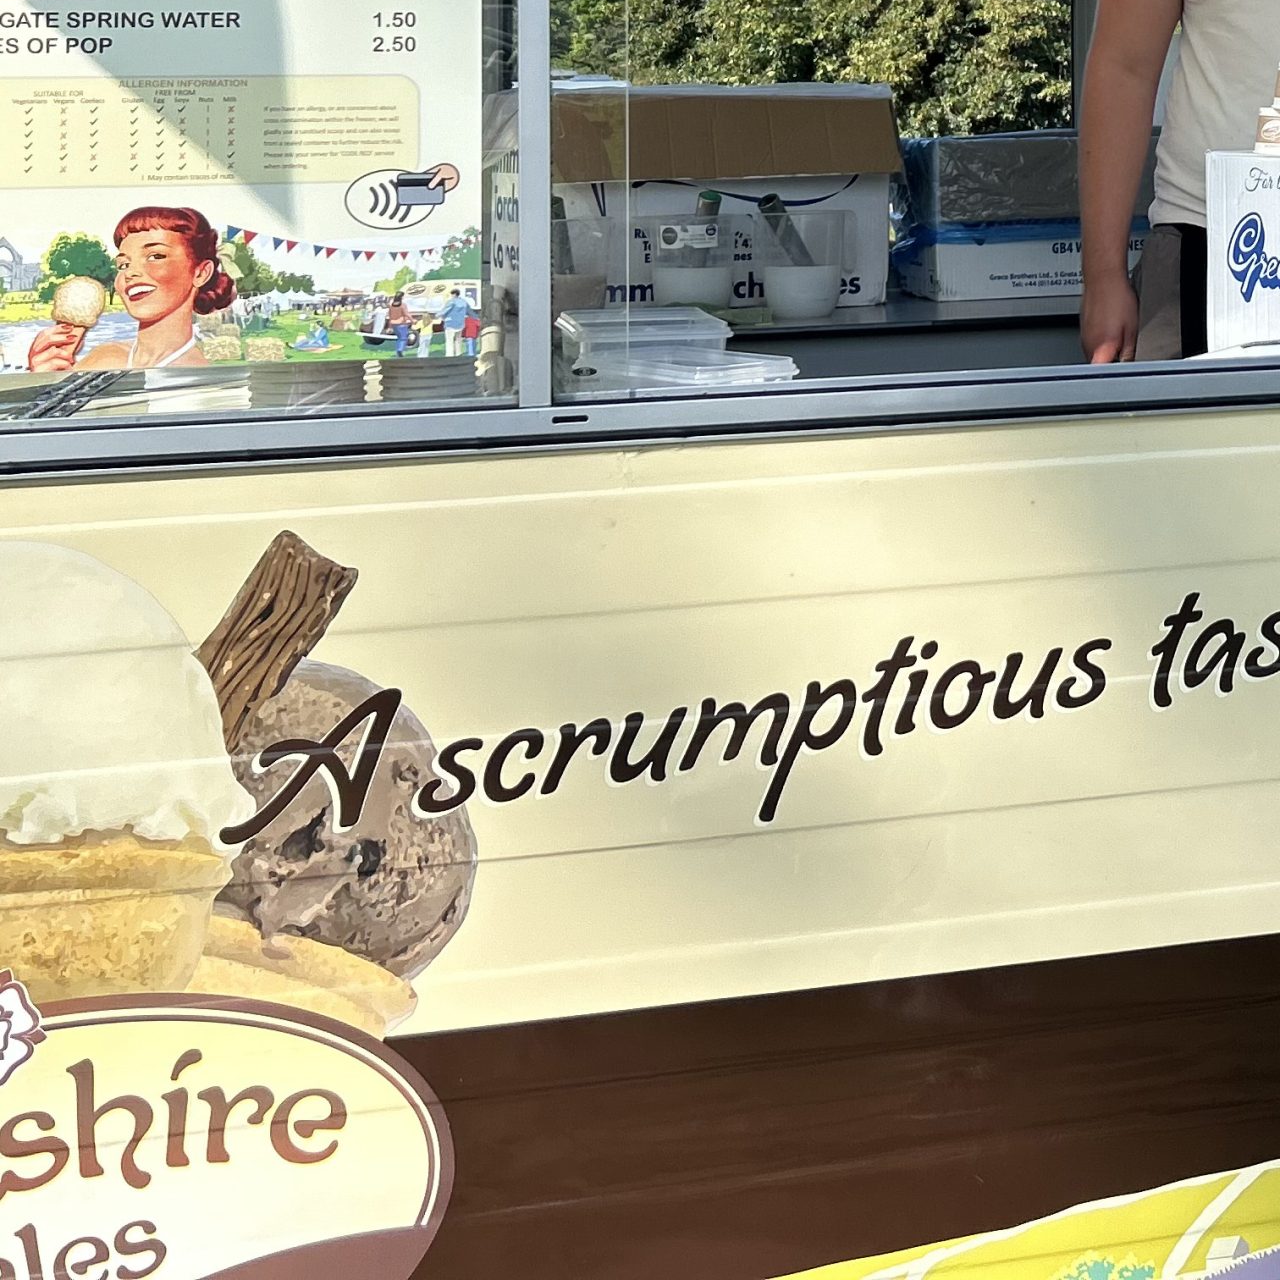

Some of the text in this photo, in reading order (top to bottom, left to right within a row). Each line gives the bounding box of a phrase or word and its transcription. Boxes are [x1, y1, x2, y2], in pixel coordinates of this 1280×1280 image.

[0, 11, 241, 29] GATE SPRING WATER
[372, 11, 417, 28] 1.50
[27, 37, 58, 54] OF
[65, 36, 113, 54] POP
[372, 36, 417, 53] 2.50
[118, 78, 248, 89] ALLERGEN INFORMATION
[1244, 166, 1273, 192] For
[1052, 242, 1073, 254] GB4
[1009, 272, 1038, 280] Brothers
[220, 685, 403, 847] A
[415, 634, 1112, 823] scrumptious
[0, 1048, 348, 1200] shire
[0, 1219, 167, 1280] les
